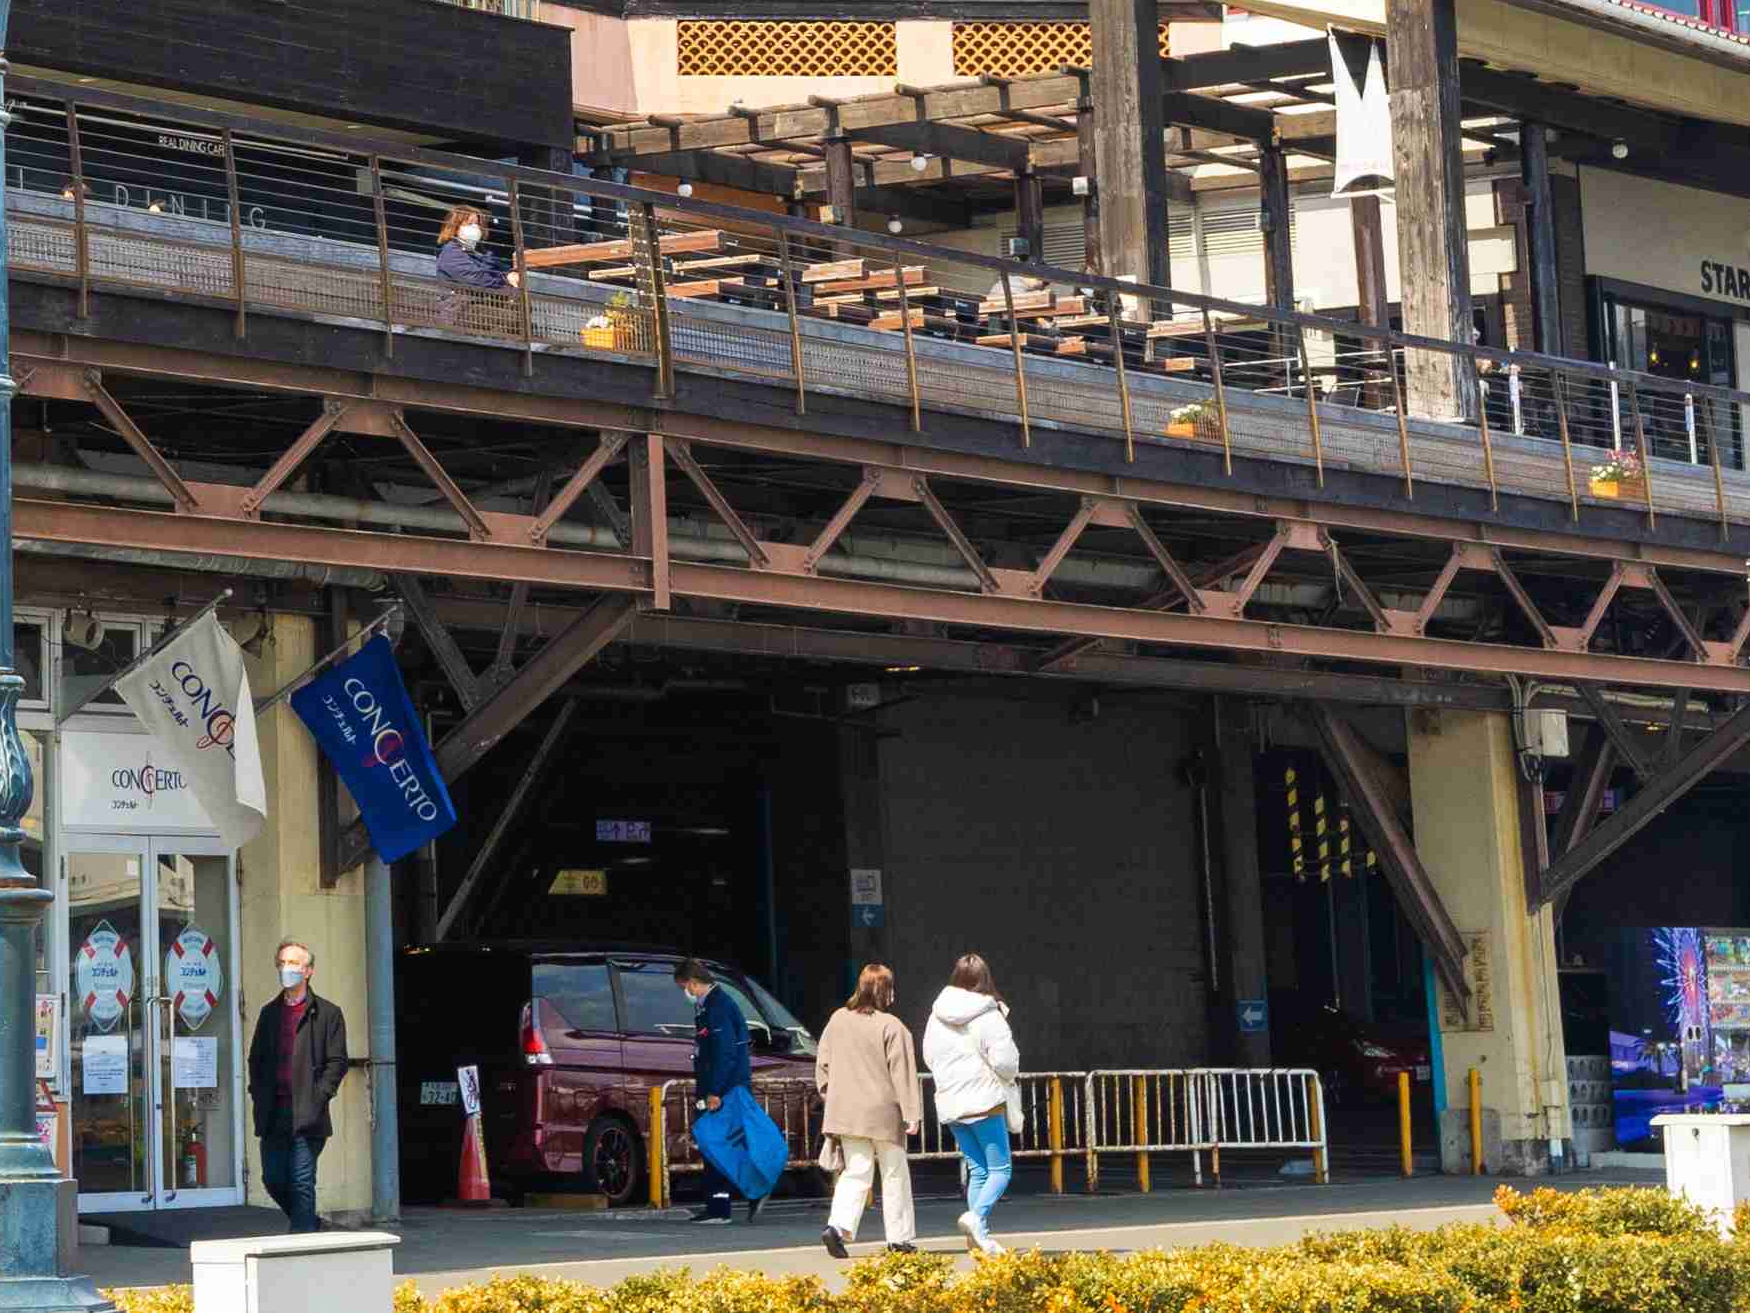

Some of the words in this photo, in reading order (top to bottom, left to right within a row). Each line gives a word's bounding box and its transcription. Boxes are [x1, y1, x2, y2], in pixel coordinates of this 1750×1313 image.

[150, 679, 189, 728] コンチェルト
[322, 694, 357, 745] コンチェルト
[343, 677, 437, 822] CONCERTO
